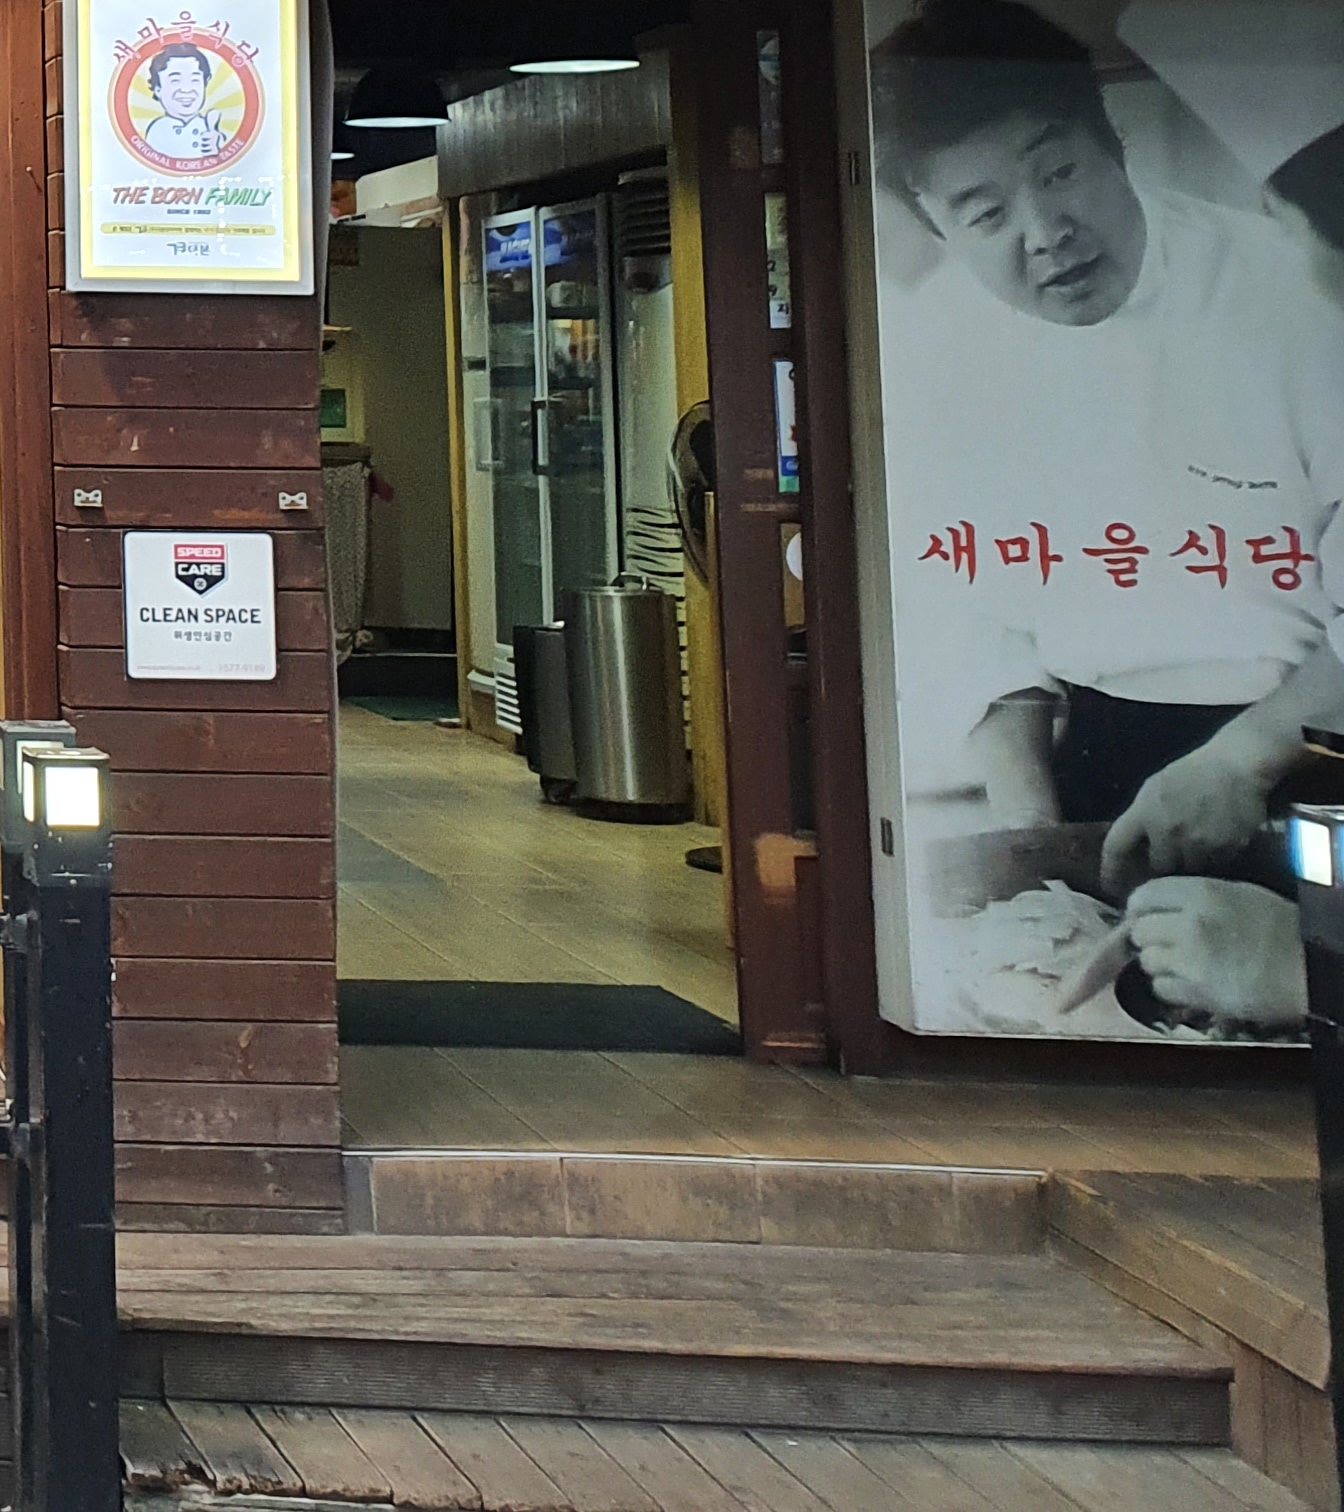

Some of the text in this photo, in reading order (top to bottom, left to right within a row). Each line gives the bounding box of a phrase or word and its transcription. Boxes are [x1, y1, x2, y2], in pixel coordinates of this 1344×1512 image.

[113, 11, 260, 67] 새마을식당
[131, 135, 245, 171] ORIGINAL KOREAN TASTE
[113, 187, 272, 206] THE BORN FAMILY
[177, 547, 222, 557] SPEED
[918, 520, 1315, 591] 새마을식당
[177, 564, 223, 576] CARE
[140, 607, 261, 624] CLEAN SPACE
